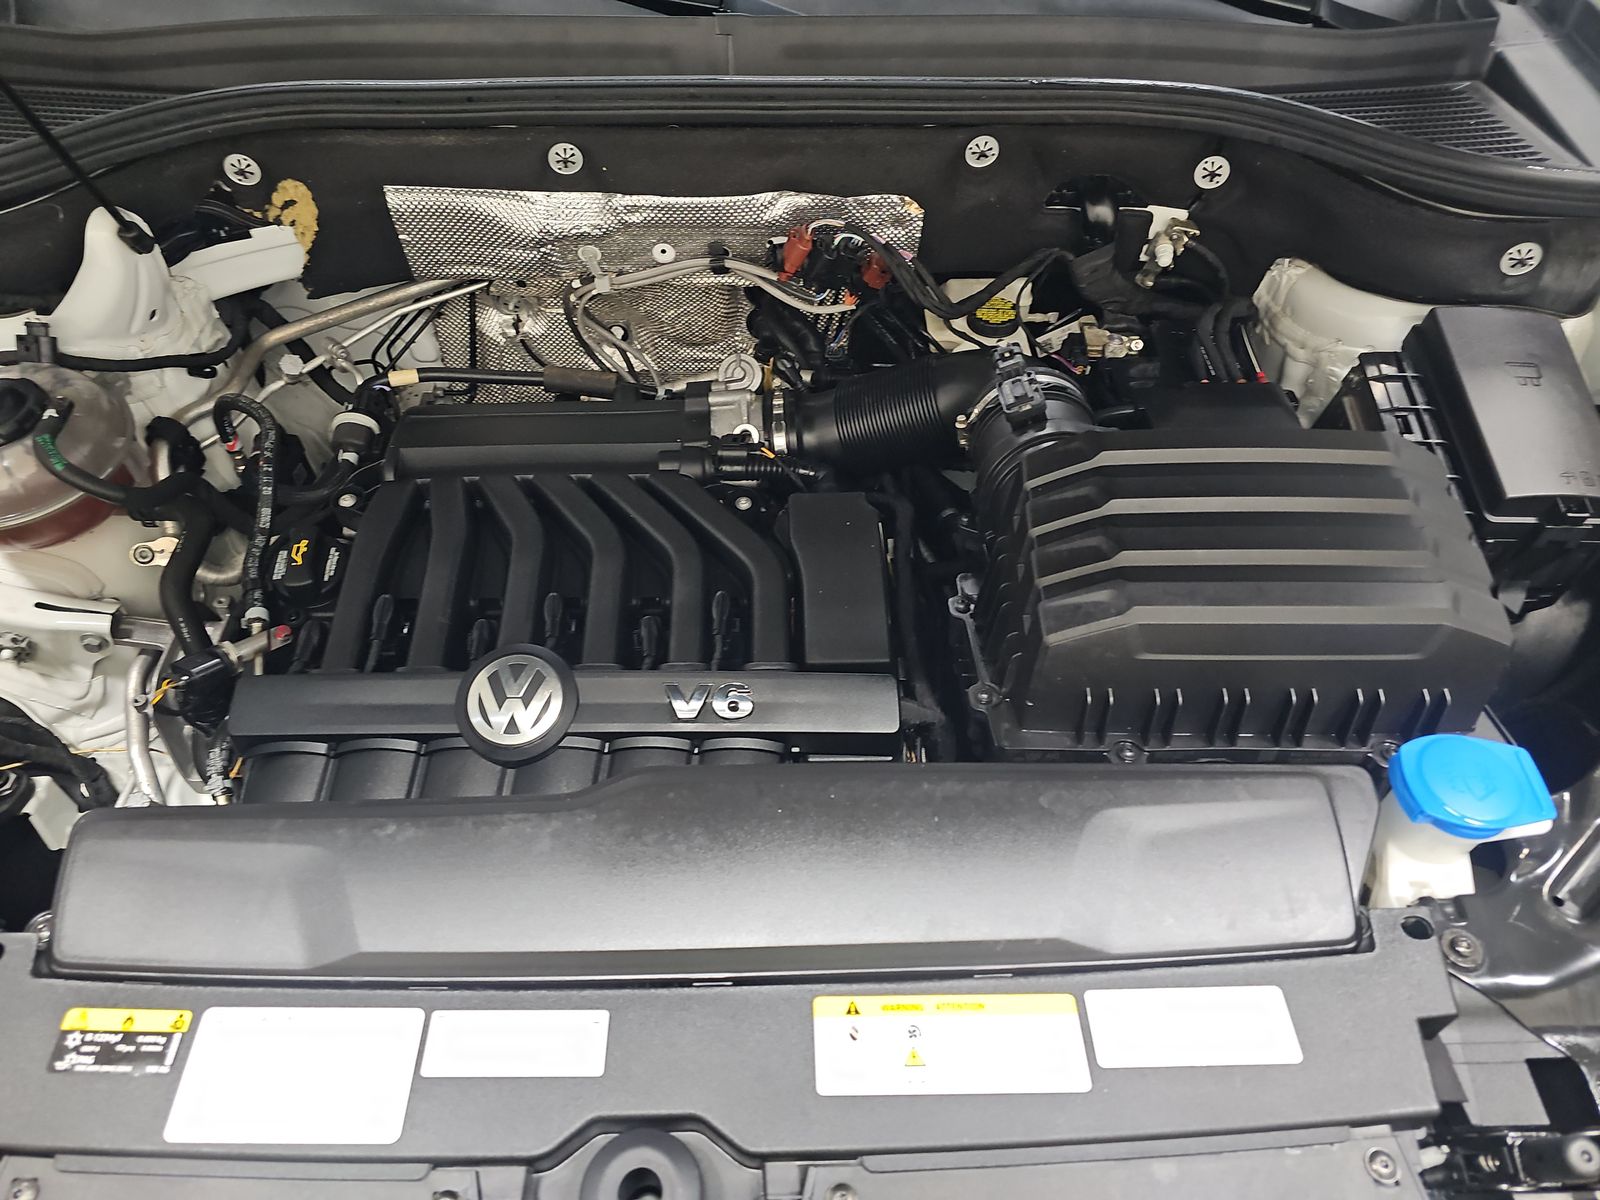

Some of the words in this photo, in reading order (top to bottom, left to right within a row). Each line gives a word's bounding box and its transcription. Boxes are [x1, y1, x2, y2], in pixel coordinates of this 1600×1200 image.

[467, 655, 563, 745] VW
[663, 682, 754, 720] V6
[881, 1003, 924, 1011] WARNING
